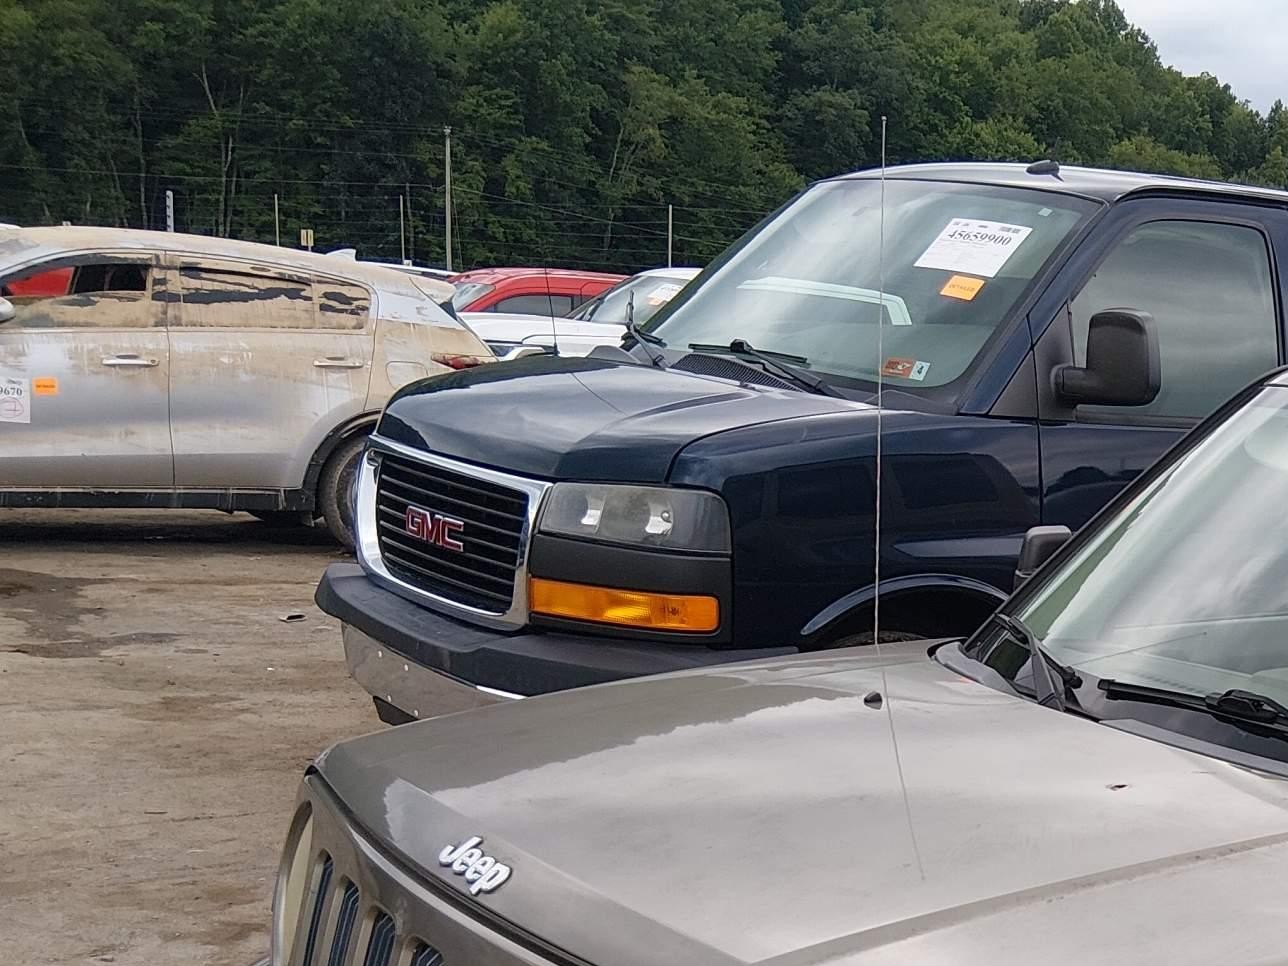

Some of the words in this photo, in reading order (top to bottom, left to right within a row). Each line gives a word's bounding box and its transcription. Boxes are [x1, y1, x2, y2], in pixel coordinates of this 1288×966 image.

[948, 229, 1012, 246] 45659900
[406, 505, 464, 552] GMC
[439, 835, 512, 895] Jeep
